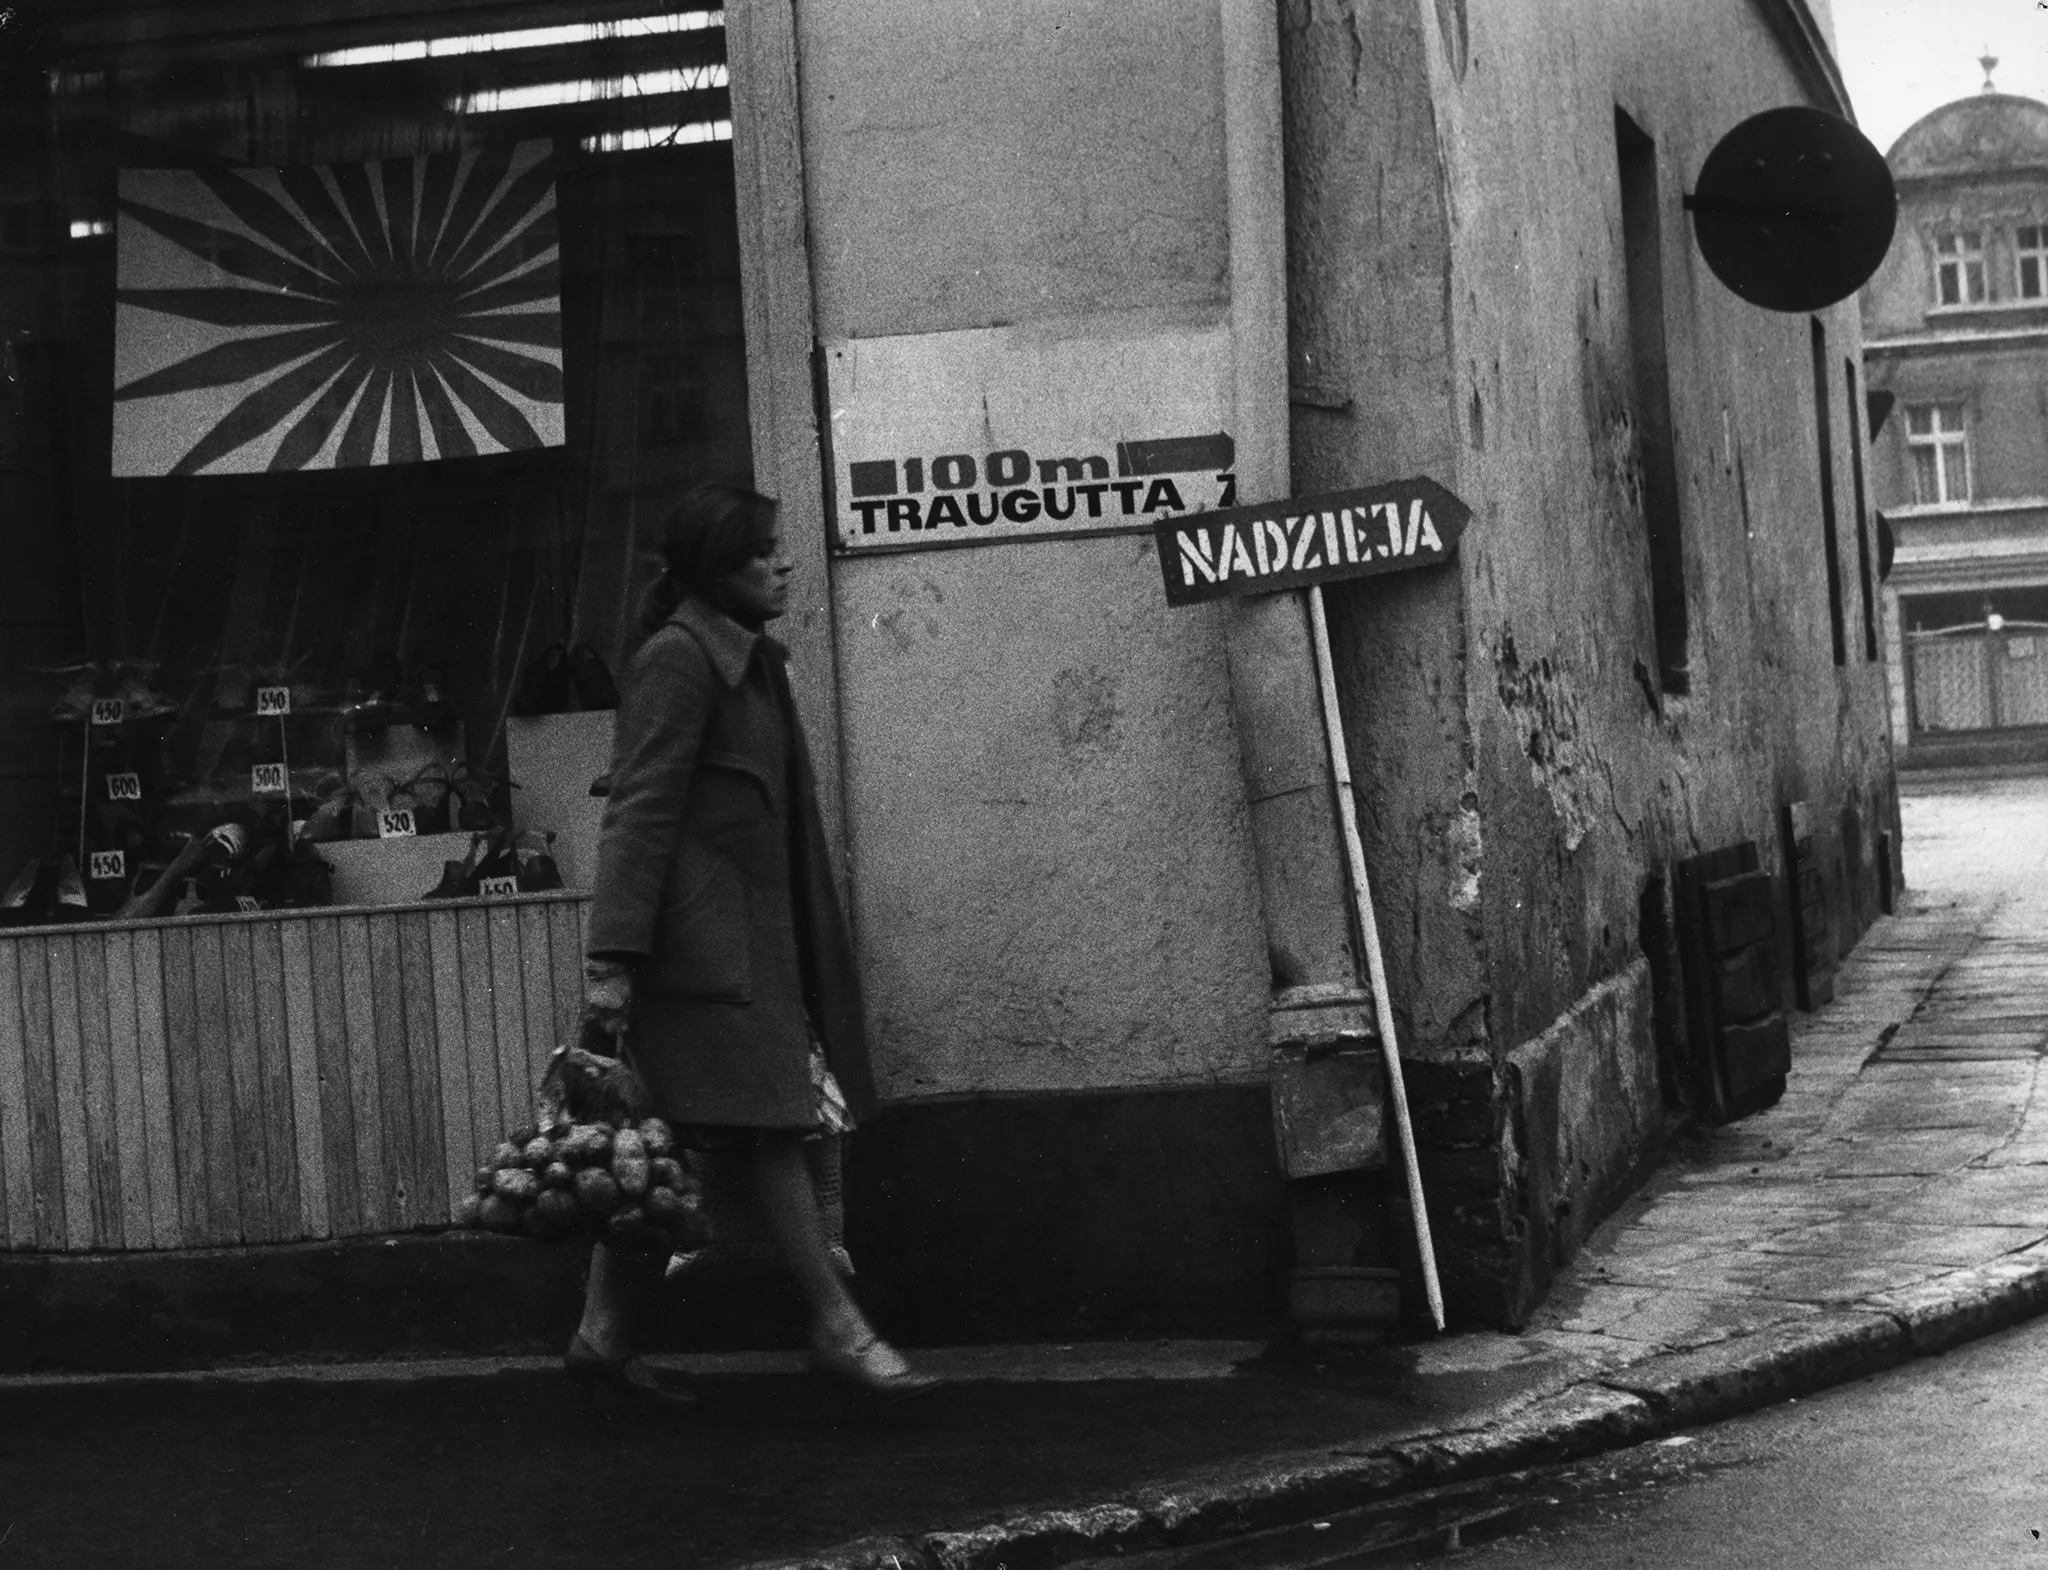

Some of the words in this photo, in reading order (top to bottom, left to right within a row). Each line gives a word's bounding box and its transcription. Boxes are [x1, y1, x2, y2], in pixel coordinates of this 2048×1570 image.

[904, 449, 1110, 493] 100m
[850, 478, 1185, 535] TRAUGUTTA
[1176, 499, 1443, 586] NADZIEJA
[95, 700, 121, 721] 450
[383, 812, 411, 834] 520
[93, 854, 121, 875] 450
